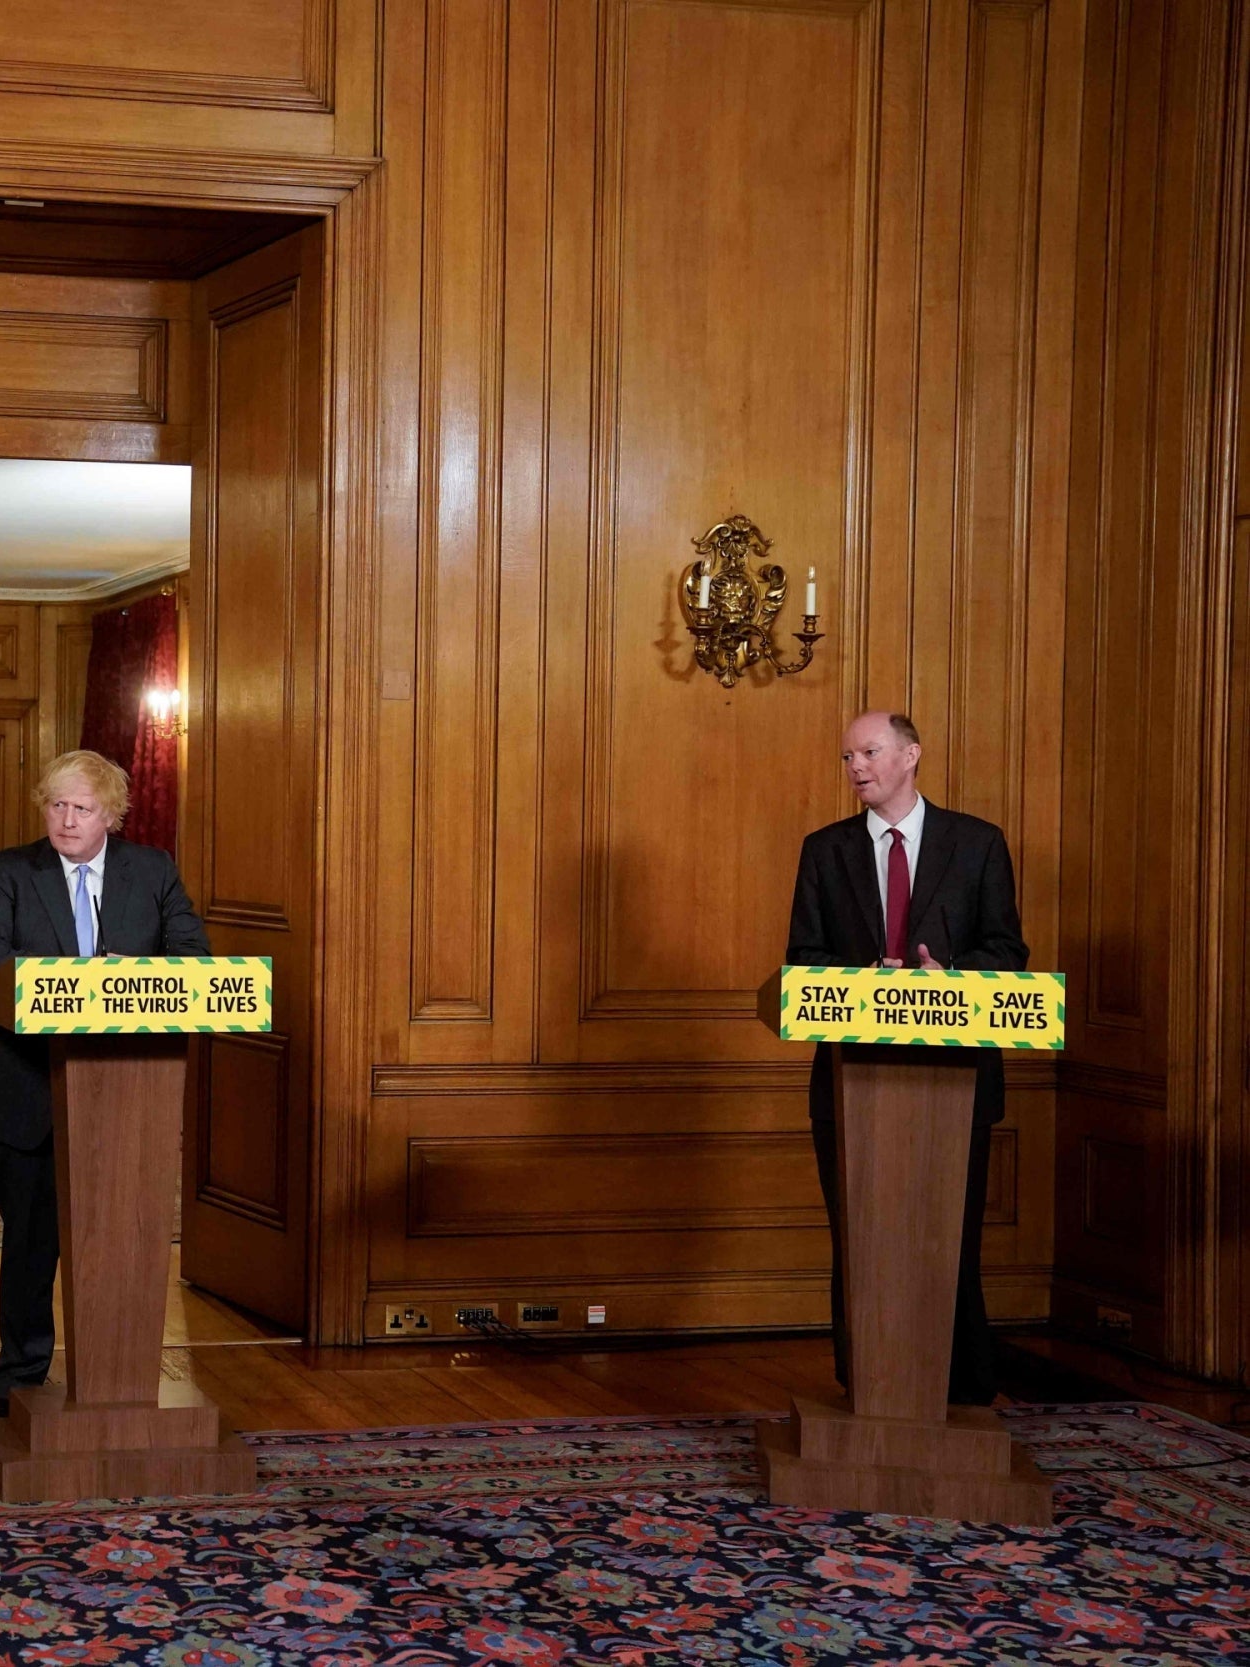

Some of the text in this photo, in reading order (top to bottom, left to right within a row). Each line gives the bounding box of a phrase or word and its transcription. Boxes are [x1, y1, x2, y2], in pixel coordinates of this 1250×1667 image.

[33, 977, 80, 995] STAY
[101, 977, 189, 995] CONTROL
[208, 976, 255, 994] SAVE
[800, 985, 849, 1004] STAY
[872, 987, 969, 1008] CONTROL
[992, 991, 1045, 1011] SAVE
[29, 997, 85, 1014] ALERT
[101, 997, 189, 1014] THE VIRUS
[205, 996, 258, 1014] LIVES
[795, 1005, 855, 1023] ALERT
[873, 1008, 970, 1027] THE VIRUS
[988, 1011, 1048, 1030] LIVES
